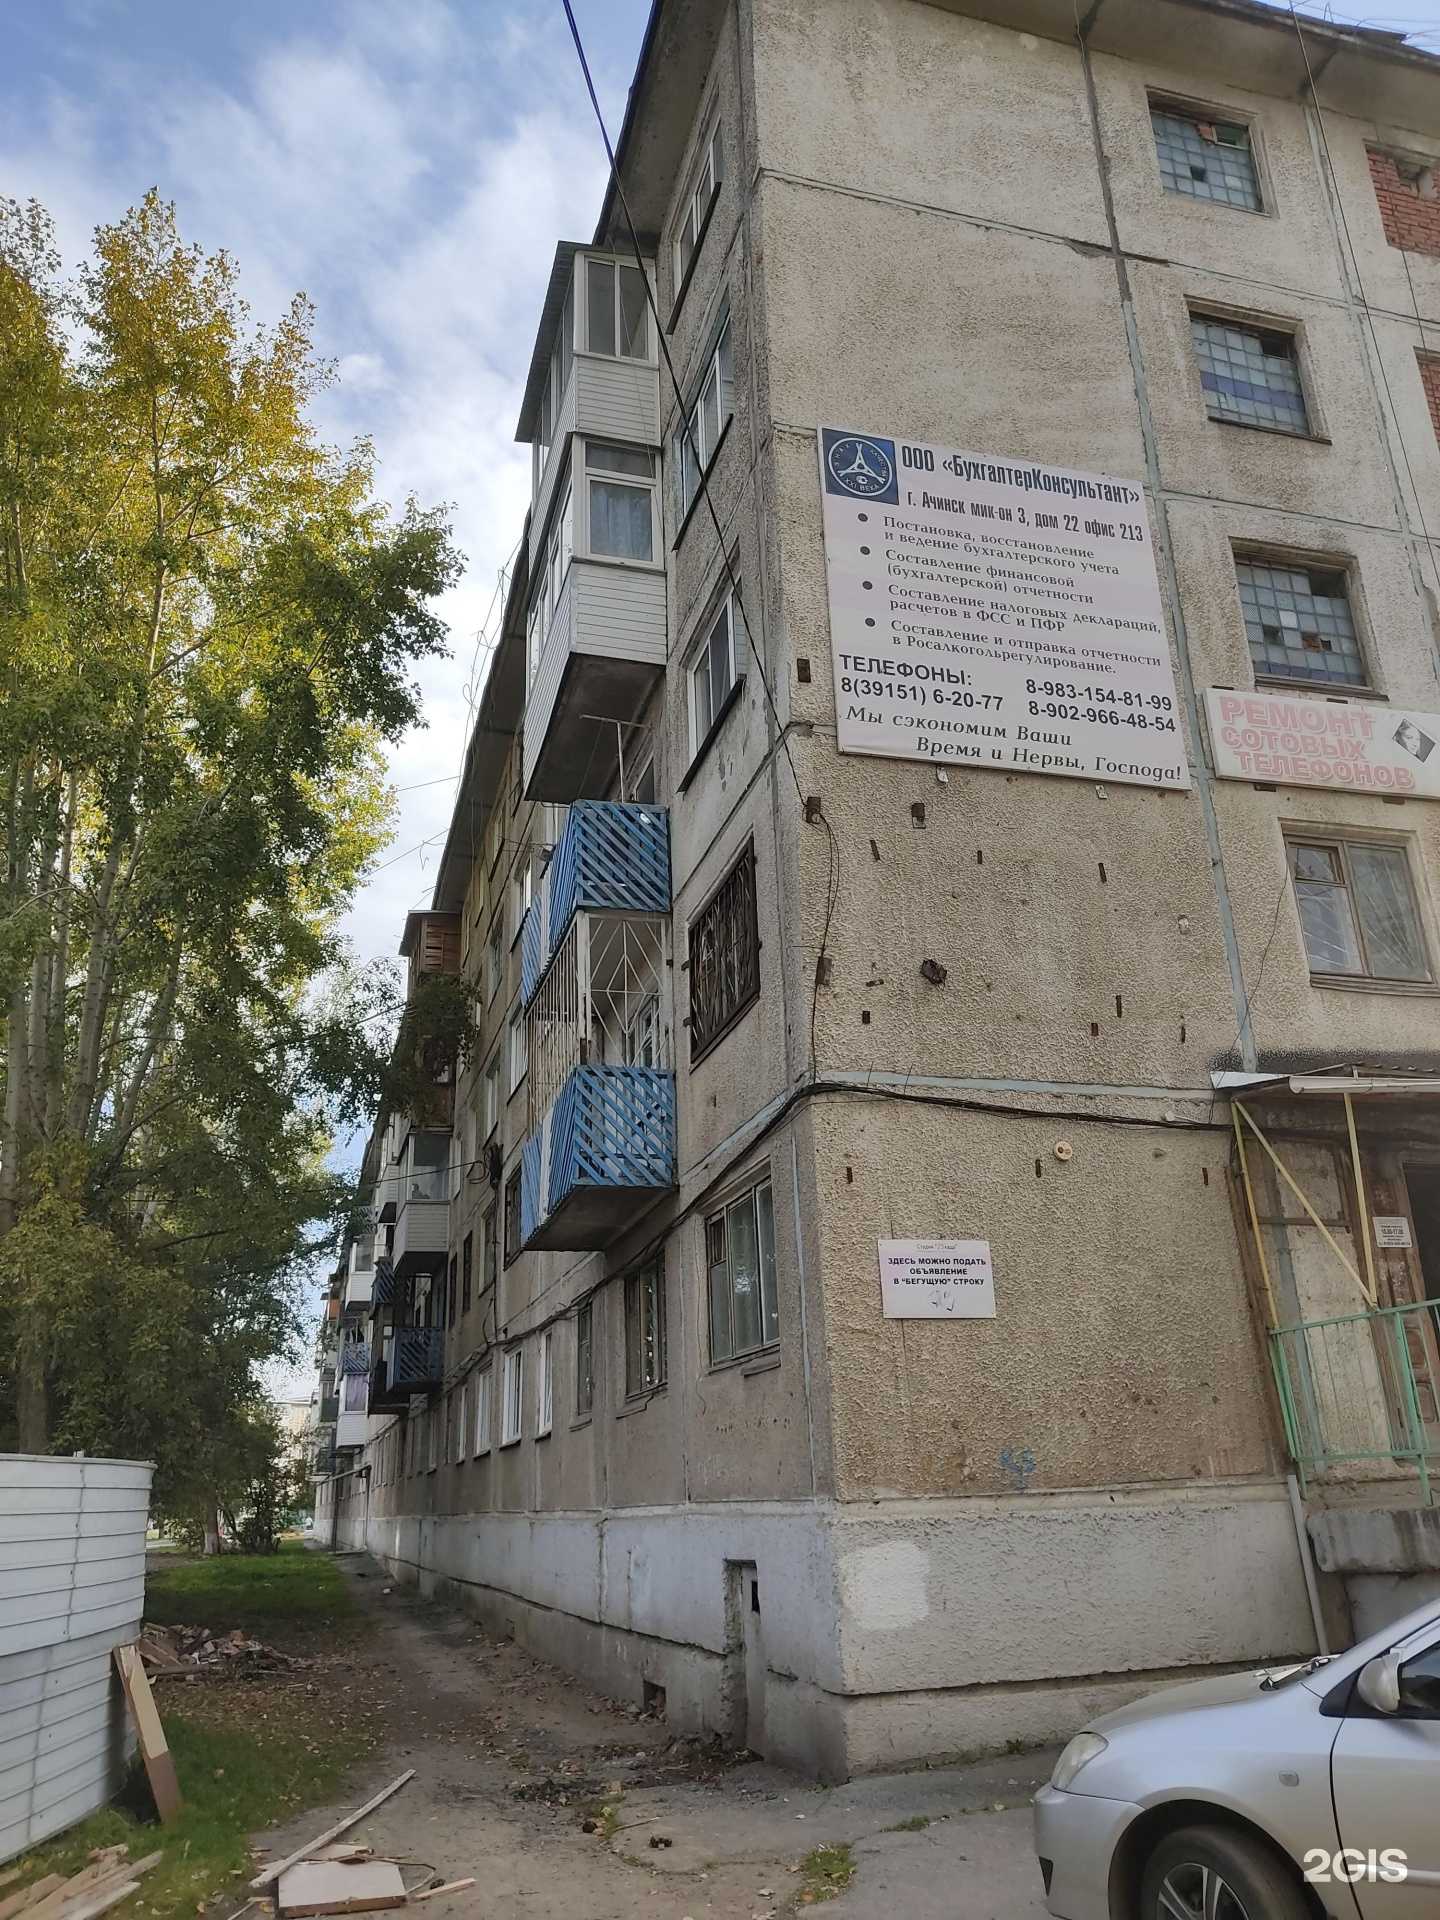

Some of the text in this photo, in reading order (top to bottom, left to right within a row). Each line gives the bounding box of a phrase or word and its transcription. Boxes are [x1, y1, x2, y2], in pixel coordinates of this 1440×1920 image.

[860, 484, 880, 492] ВЕКА
[902, 445, 1140, 504] ООО «БухгалтерКонсультант»
[908, 492, 1143, 541] г. Ачинск мик-он 3, дом 22 офис 213
[884, 516, 1095, 559] Постановка, восстановление
[885, 531, 1119, 575] и ведение бухгалтерского учета
[885, 549, 1075, 588] Составление финансовой
[887, 563, 1094, 604] (бухгалтерской) отчетности
[888, 584, 1161, 634] Составление налоговых деклараций,
[889, 600, 1065, 632] расчетов в ФСС и ПФР
[891, 620, 1161, 666] Составление и отправка отчетности
[892, 635, 1117, 674] в Росалкогольрегулирование.
[839, 654, 972, 686] ТЕЛЕФОНЫ:
[841, 677, 1003, 711] 8(39151) 6-20-77
[1026, 678, 1172, 711] 8-983-154-81-99
[846, 705, 1072, 746] Мы сэкономим Ваши
[1028, 700, 1176, 732] 8-902-966-48-54
[1219, 695, 1376, 738] РЕМОНТ
[916, 736, 1181, 782] Время и Нервы, Господа!
[1221, 726, 1366, 761] СОТОВЫХ
[1234, 750, 1416, 789] ТЕЛЕФОНОВ
[953, 1258, 986, 1266] ПОДАТЬ
